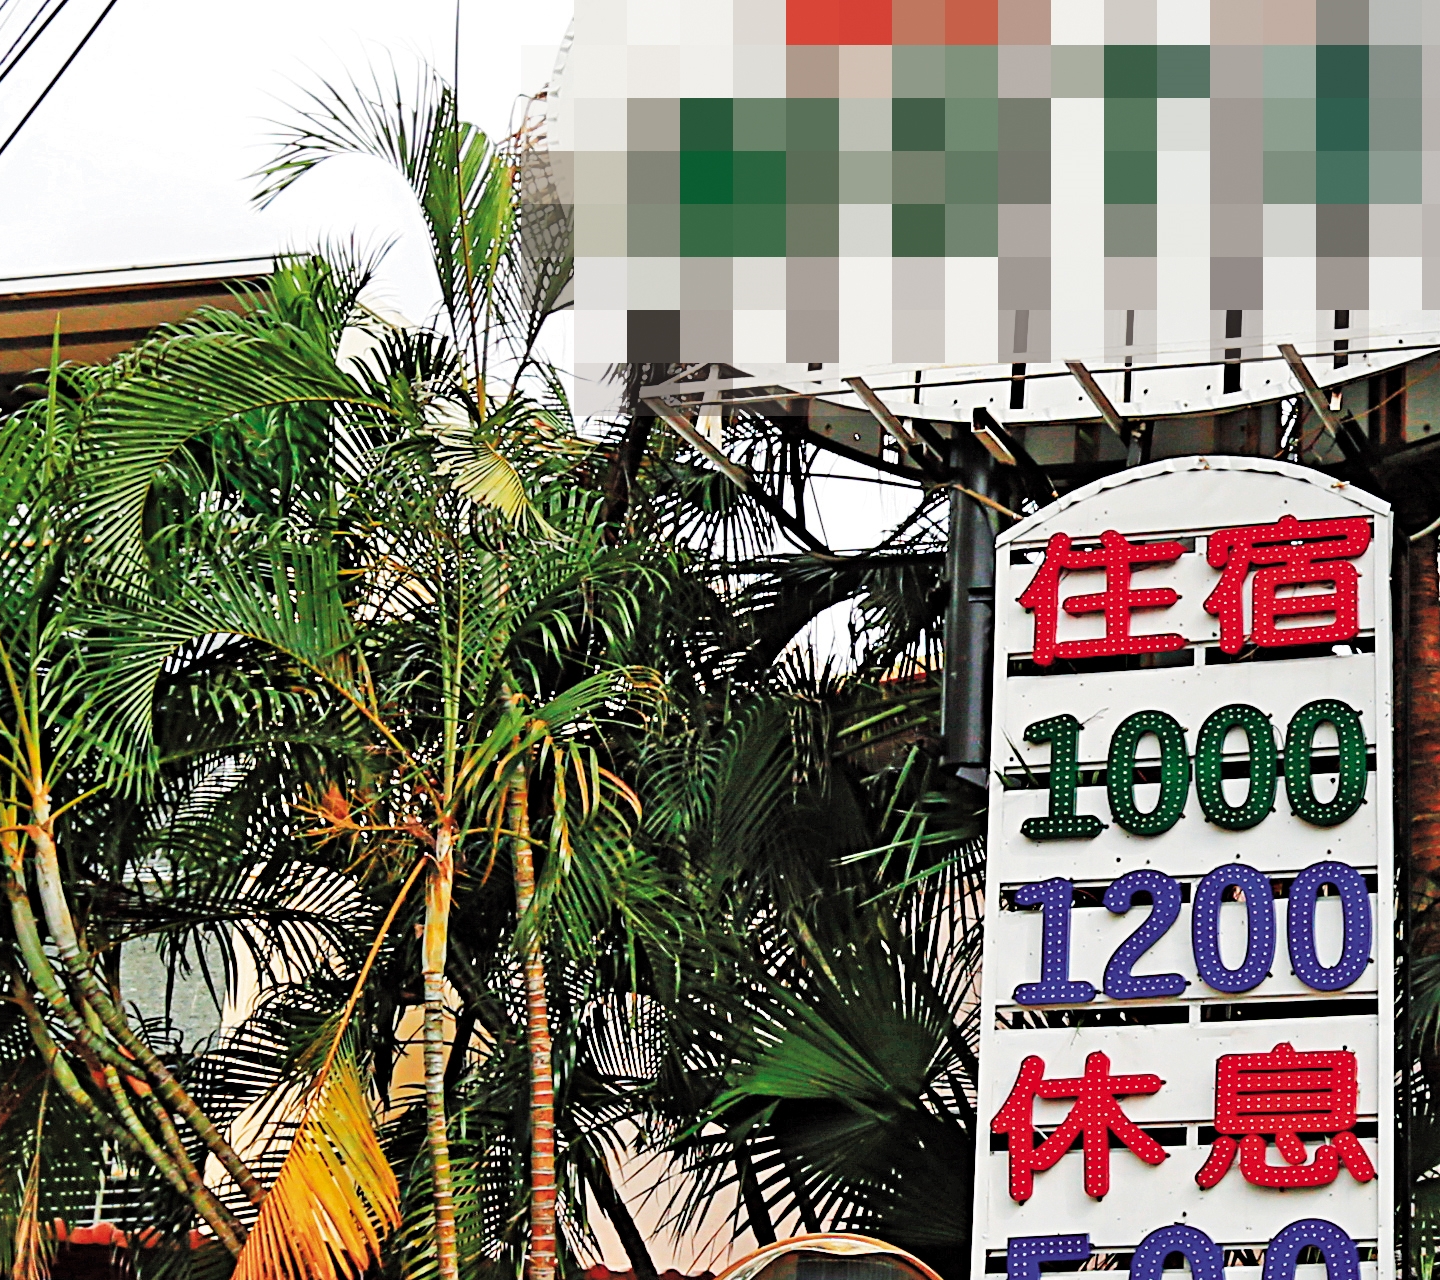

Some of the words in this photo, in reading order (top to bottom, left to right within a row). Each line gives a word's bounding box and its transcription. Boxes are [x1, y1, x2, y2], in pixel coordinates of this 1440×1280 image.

[1015, 514, 1372, 666] 住宿
[1020, 698, 1369, 840] 1000
[1012, 861, 1374, 1006] 1200
[990, 1042, 1378, 1203] 休息
